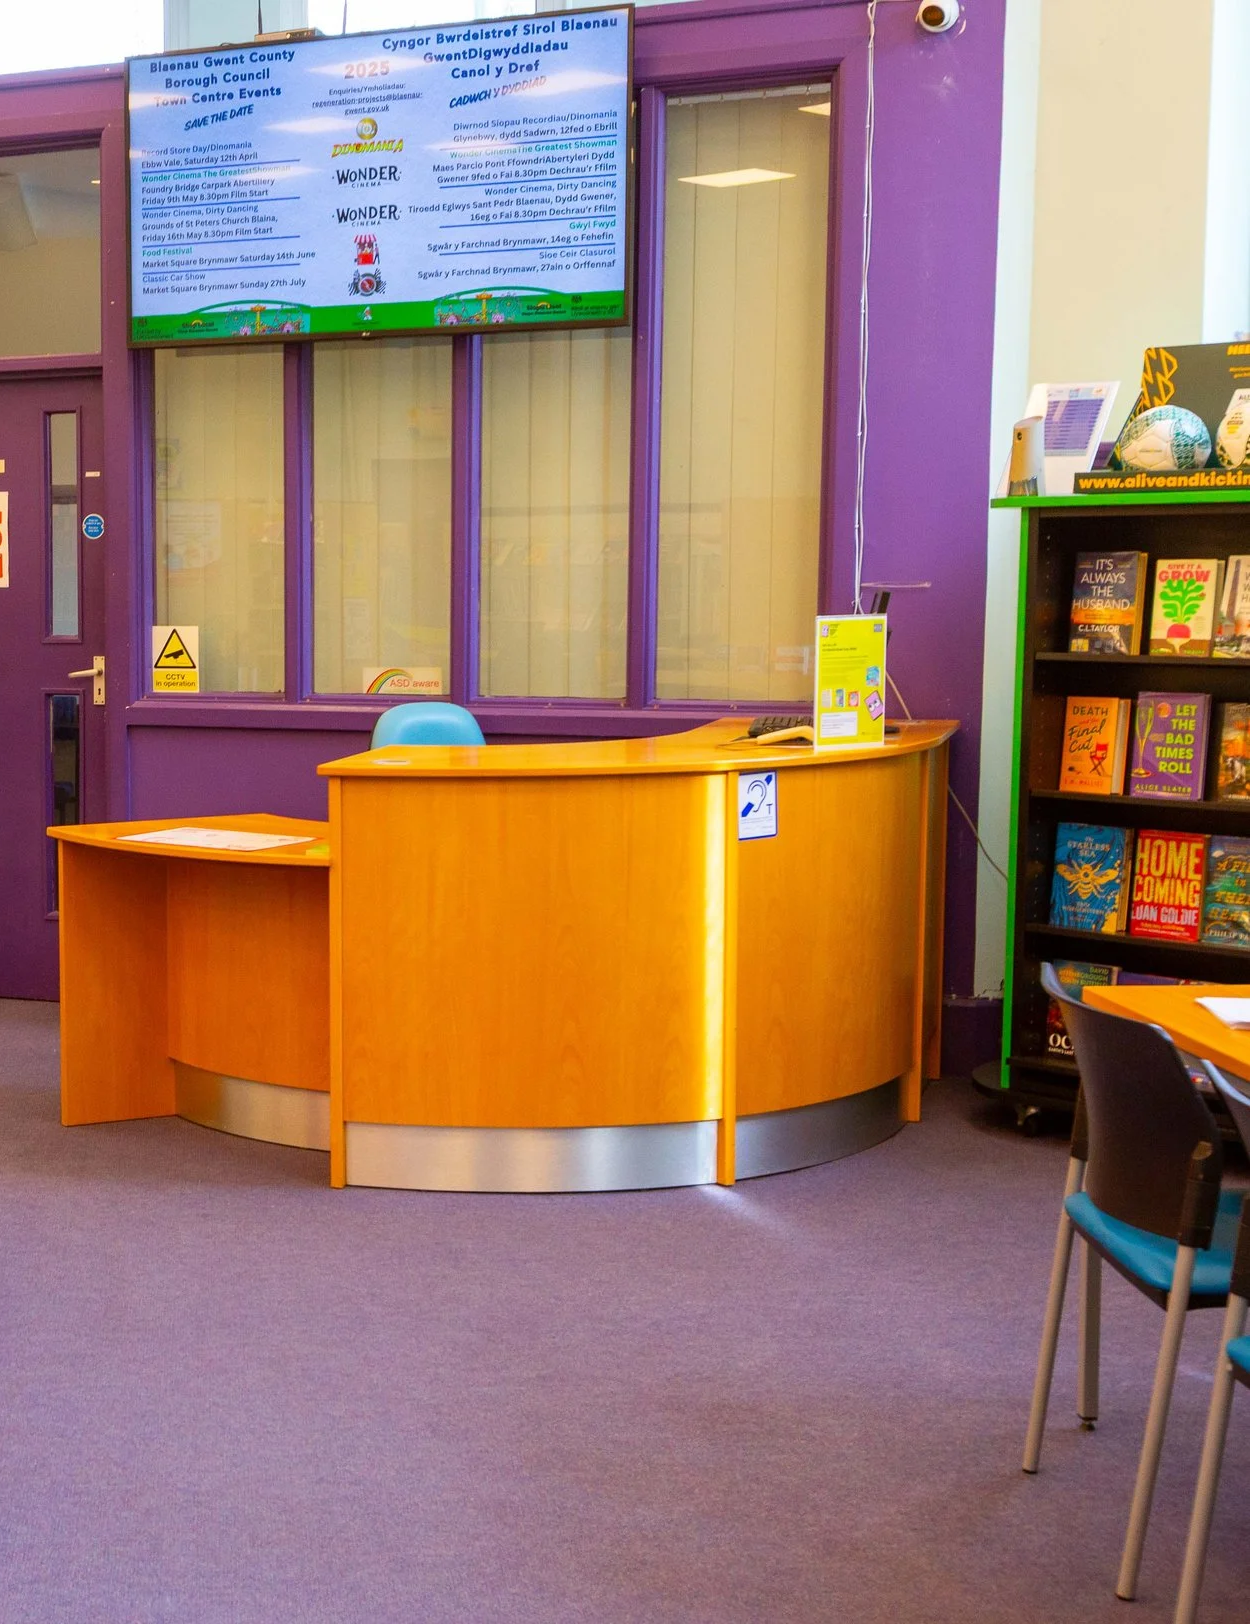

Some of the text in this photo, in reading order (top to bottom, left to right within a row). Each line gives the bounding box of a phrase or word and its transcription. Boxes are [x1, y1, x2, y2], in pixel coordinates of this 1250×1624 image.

[382, 17, 617, 52] Cyngor Bwrdeistref Sirol Blaenau
[149, 49, 295, 73] Blaenau Gwent County
[451, 59, 539, 79] Canol y Dref
[165, 67, 269, 89] Borough Council
[344, 62, 390, 79] 2025
[152, 85, 281, 108] Town Centre Events
[449, 75, 547, 108] CADWCH Y DYDDIAD
[184, 103, 254, 131] SAVE THE DATE
[453, 109, 617, 131] Diwrnod Siopau Recordiau/Dinomania
[331, 138, 403, 157] DINOMANIA
[141, 151, 258, 169] Ebbw Vale, Saturday 12th April
[336, 165, 400, 184] WONDER
[437, 175, 469, 183] Gwener
[471, 171, 490, 181] 9fed
[500, 170, 512, 178] Fai
[514, 168, 547, 178] 8.30pm
[549, 164, 592, 175] Dechrau'r
[594, 162, 616, 171] Ffilm
[141, 178, 275, 194] Foundry Bridge Carpark Abertillery
[141, 188, 268, 206] Friday 9th May 8.30pm Film Start
[336, 204, 400, 223] WONDER
[142, 246, 192, 257] Food Festival
[142, 250, 315, 268] Market Square Brynmawr Saturday 14th June
[142, 272, 205, 283] Classic Car Show
[1095, 559, 1114, 570] IT'S
[1081, 572, 1126, 584] ALWAYS
[1158, 570, 1211, 583] GROW
[1091, 586, 1113, 597] THE
[1072, 599, 1130, 610] HUSBAND
[163, 680, 196, 689] operation
[389, 679, 410, 687] ASD
[1072, 705, 1109, 716] DEATH
[1176, 704, 1198, 717] LET
[1067, 718, 1107, 741] Final
[1171, 718, 1196, 731] THE
[1068, 739, 1094, 754] Cut
[1165, 733, 1194, 745] BAD
[1155, 747, 1194, 760] TIMES
[1158, 761, 1193, 774] ROLL
[766, 803, 773, 815] T
[1135, 838, 1205, 881] HOME
[1133, 875, 1201, 908] COMING
[1160, 906, 1199, 926] GOLDIE
[1089, 966, 1109, 975] DAVID
